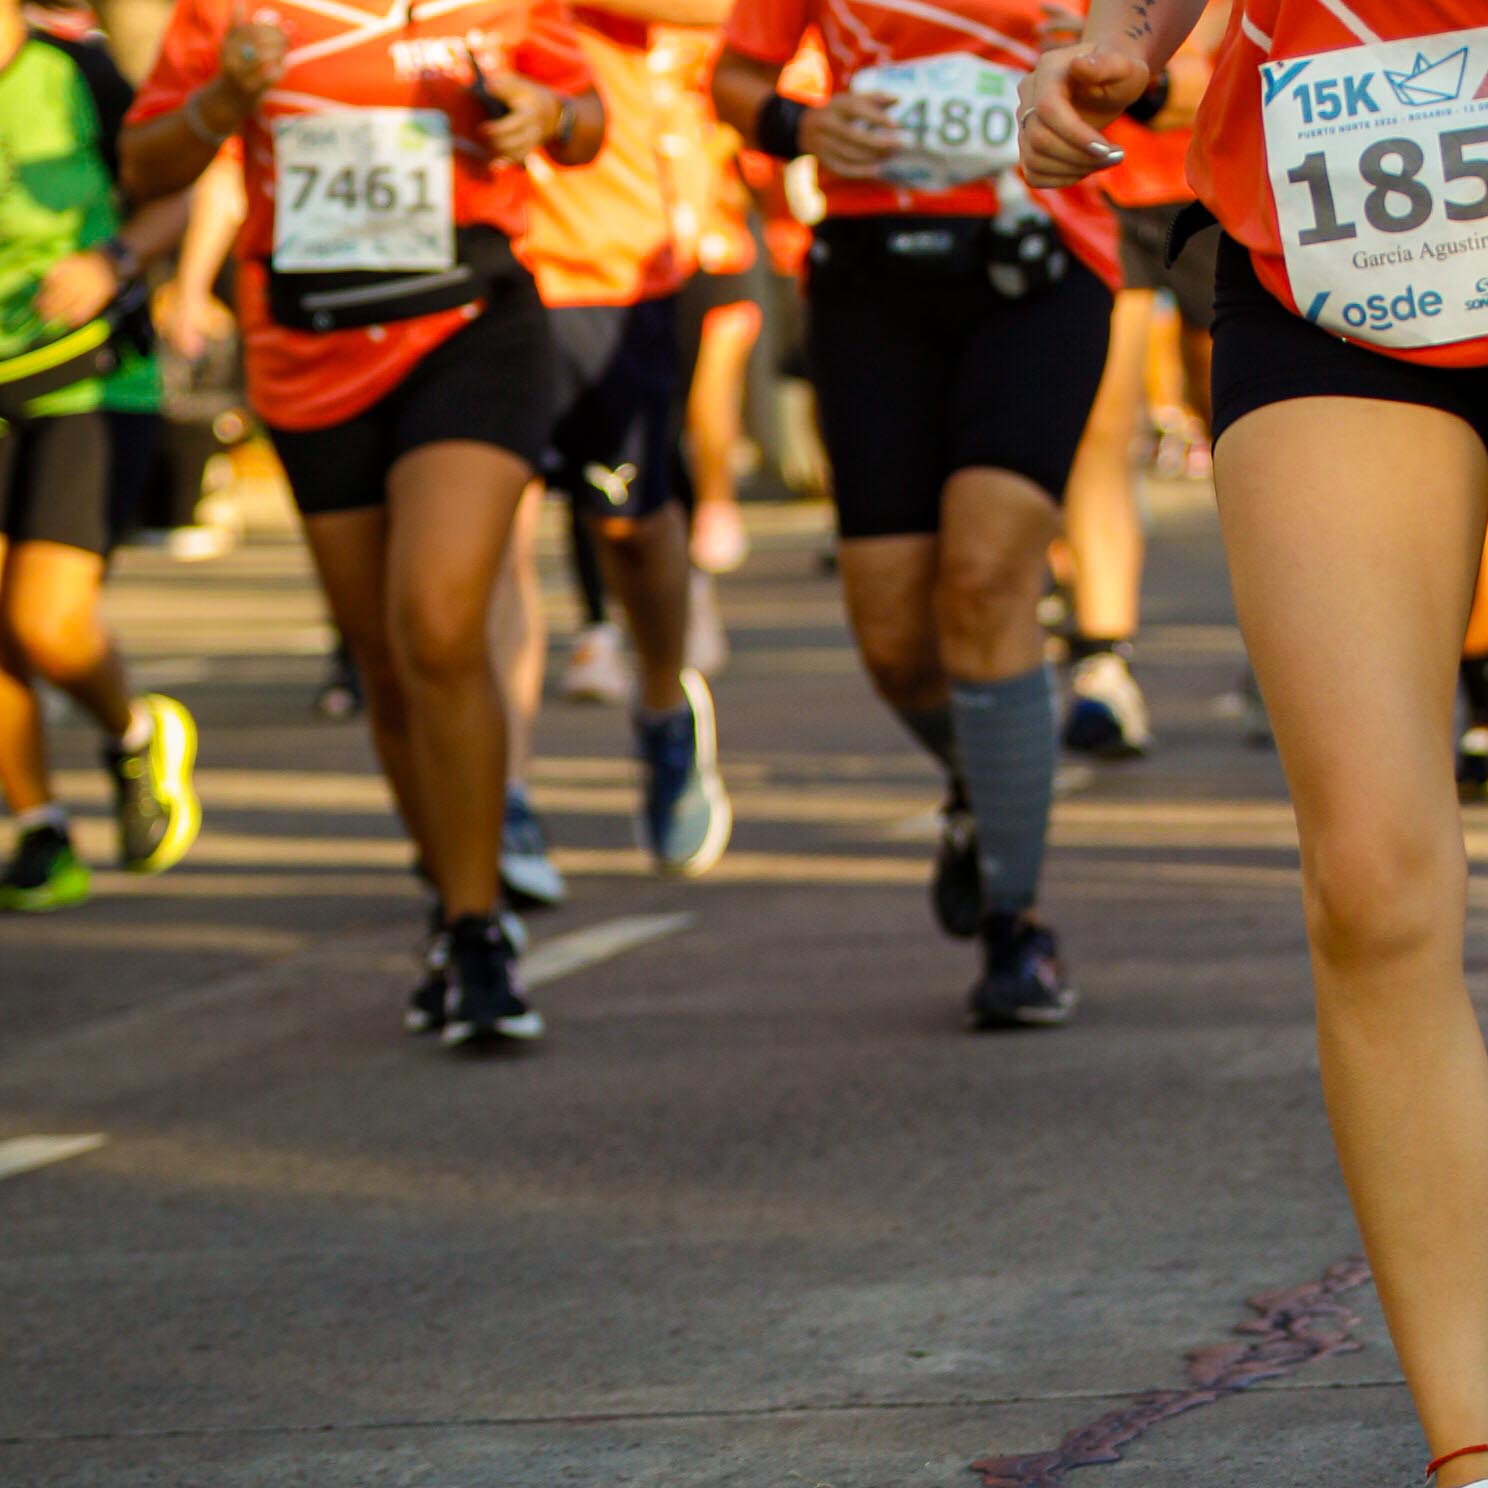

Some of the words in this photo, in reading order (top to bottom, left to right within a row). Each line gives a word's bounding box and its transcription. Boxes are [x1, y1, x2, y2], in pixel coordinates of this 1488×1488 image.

[1293, 72, 1381, 125] 15K
[866, 98, 1015, 147] 480
[1297, 126, 1336, 139] PUERTO
[286, 165, 434, 212] 7461
[1342, 285, 1444, 331] osde
